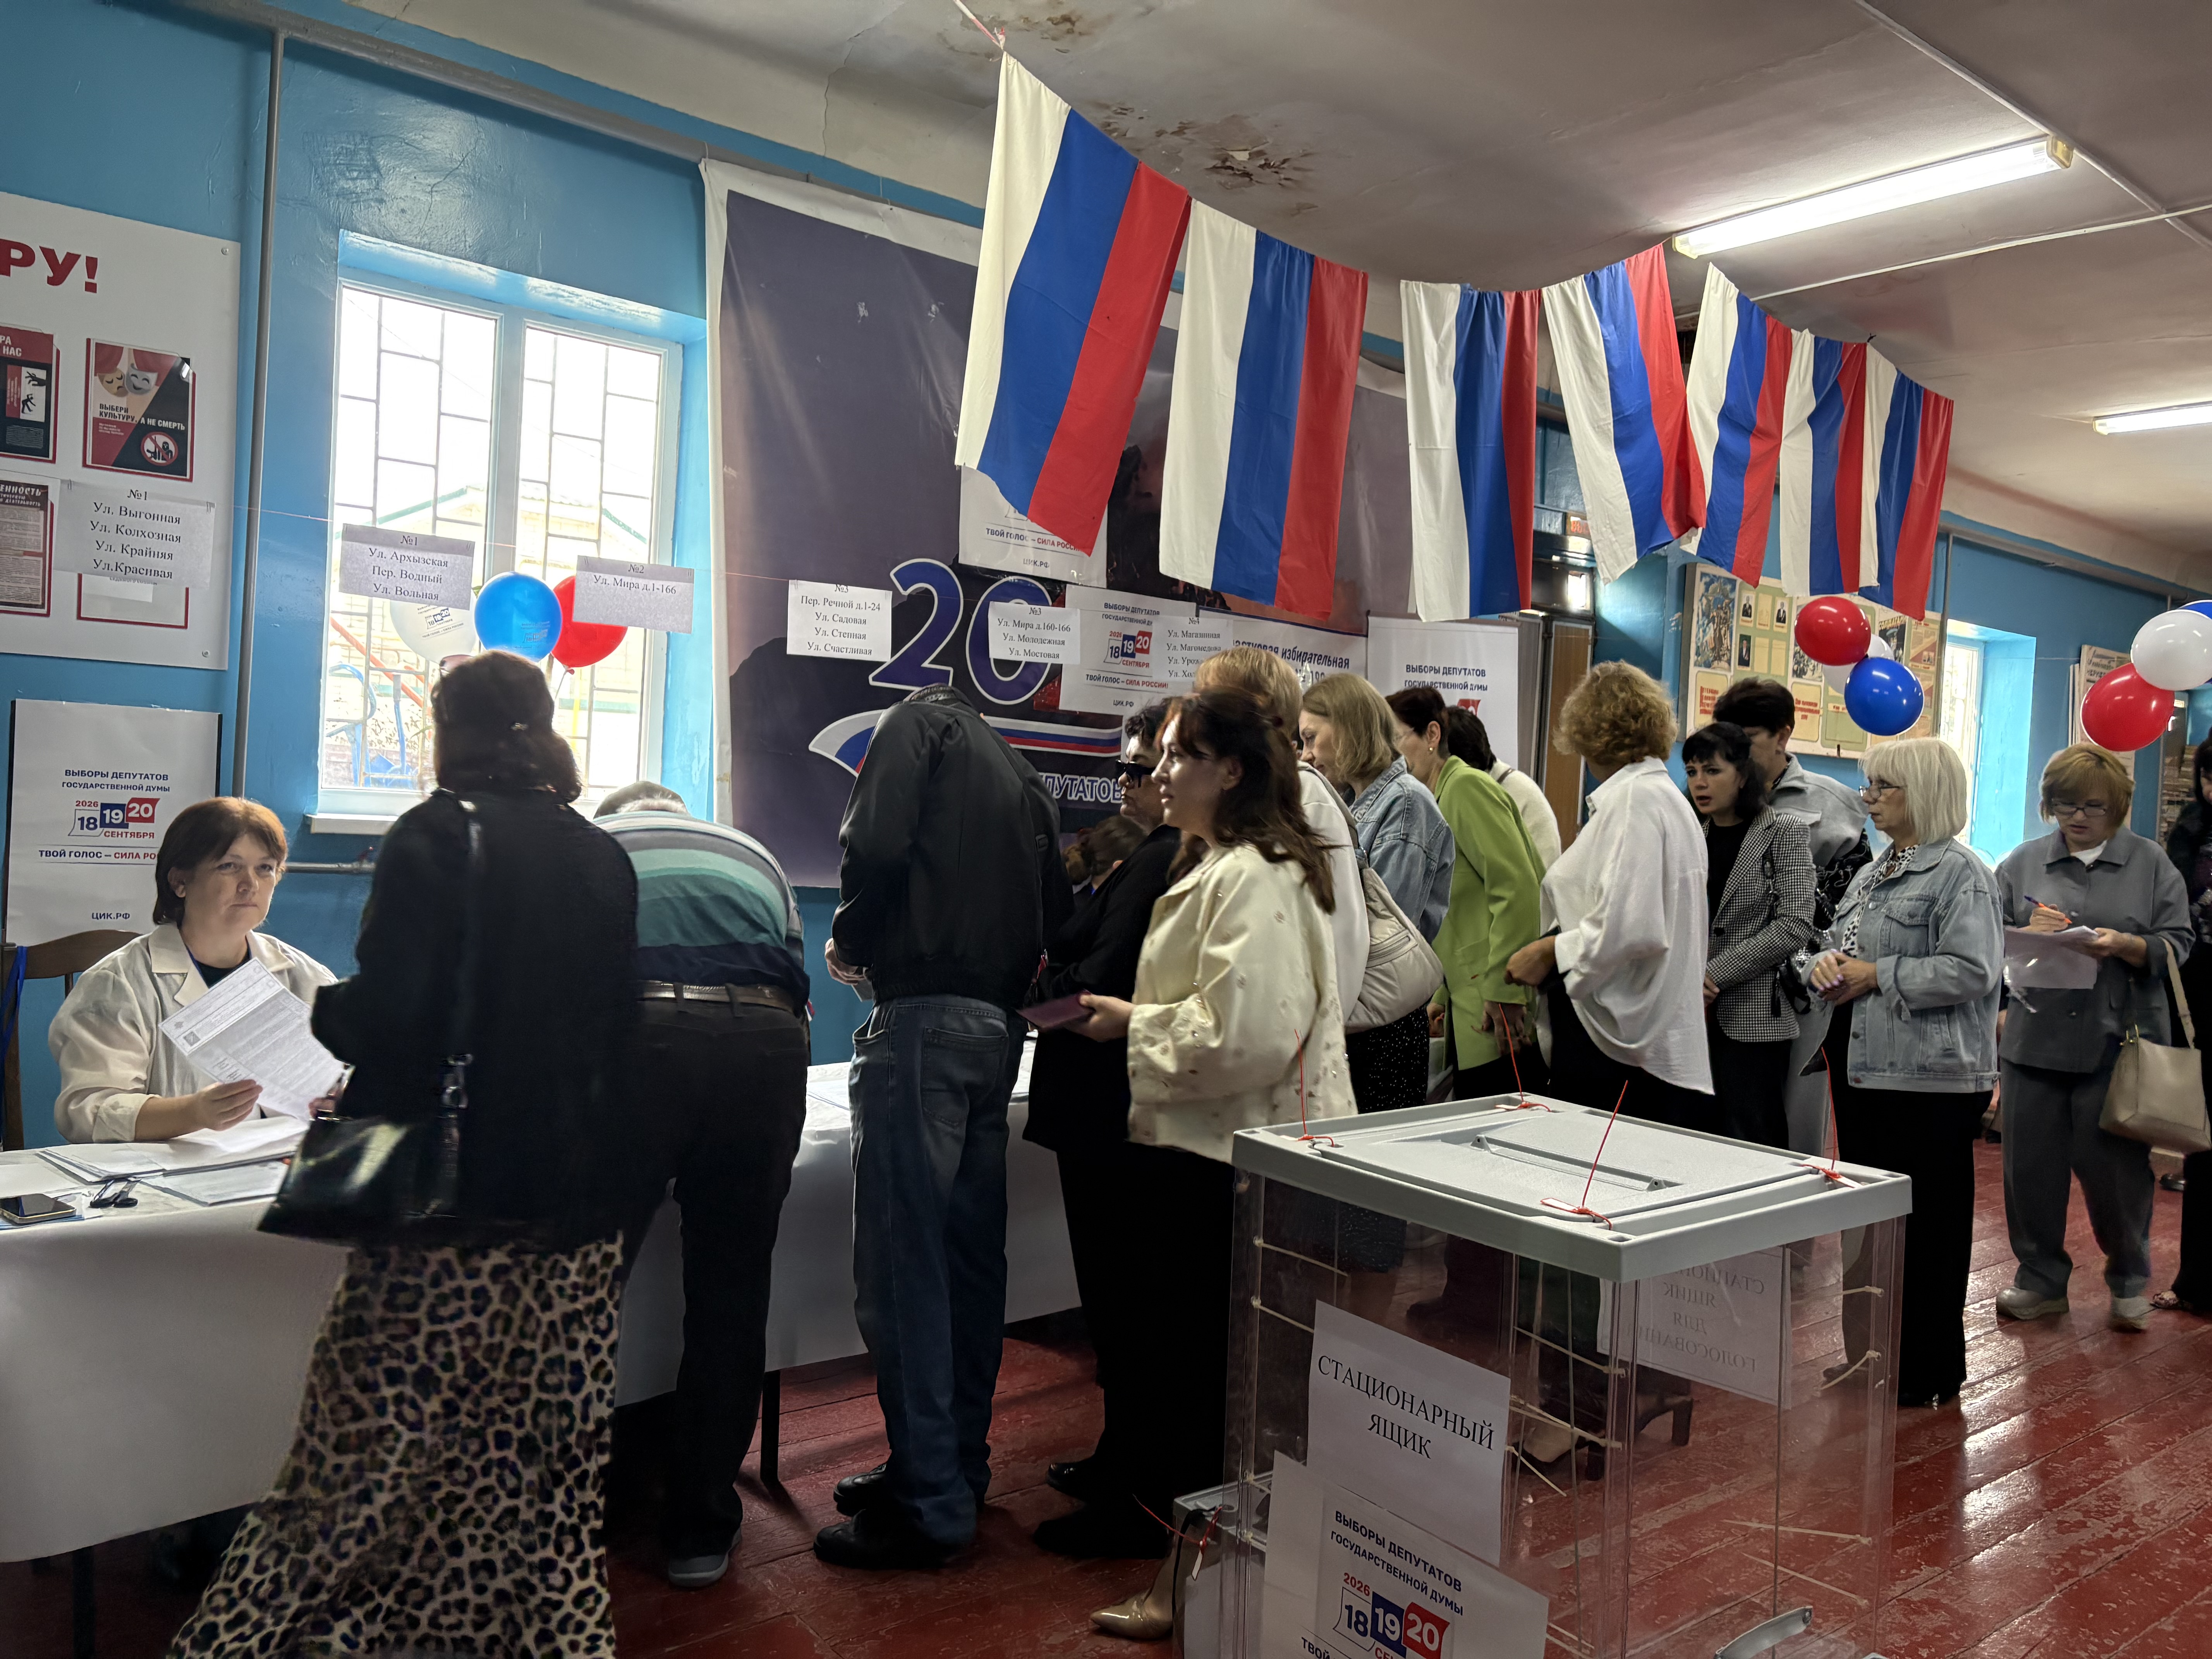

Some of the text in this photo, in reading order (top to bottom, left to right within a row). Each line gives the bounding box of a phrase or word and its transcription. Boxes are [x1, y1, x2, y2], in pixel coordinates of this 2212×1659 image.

[3, 345, 22, 357] НАС
[100, 403, 129, 414] ВЫБЕРИ
[158, 420, 185, 430] СМЕРТЬ
[119, 506, 180, 524] Выгонная
[90, 520, 180, 543] Ул. Колхозная
[986, 528, 1005, 538] ТВОЙ
[1006, 532, 1029, 542] ГОЛОС
[1037, 538, 1055, 547] СИЛА
[400, 535, 417, 546] №1
[96, 540, 173, 560] Ул. Крайняя
[369, 548, 448, 567] Ул. Архызская
[1023, 558, 1049, 568] ЦИК.РФ
[373, 565, 442, 584] Пер. Водный
[628, 564, 644, 574] №2
[594, 575, 610, 585] Ул.
[613, 577, 639, 591] Мира
[835, 584, 848, 593] №3
[373, 583, 439, 600] Ул. Вольная
[801, 595, 820, 607] Пер.
[823, 598, 853, 608] Речной
[1104, 603, 1130, 612] ВЫБОРЫ
[1029, 607, 1041, 615] №3
[832, 614, 866, 625] Садовая
[998, 618, 1010, 627] Ул.
[1012, 620, 1034, 630] Мира
[1102, 613, 1146, 625] ГОСУДАРСТВЕННОЙ
[815, 627, 866, 640] Ул. Степная
[1003, 632, 1065, 646] Ул. Молодежная
[1168, 630, 1220, 639] Ул. Магазинная
[807, 642, 872, 655] Ул. Счастливая
[1009, 647, 1059, 659] Ул. Мостовая
[1109, 635, 1149, 659] 18 19 20
[1122, 659, 1149, 668] СЕНТЯБРЯ
[1281, 646, 1350, 669] избирательная
[1406, 664, 1486, 677] ВЫБОРЫ ДЕПУТАТОВ
[65, 769, 168, 781] ВЫБОРЫ ДЕПУТАТОВ
[62, 781, 144, 791] ГОСУДАРСТВЕННОЙ
[1039, 773, 1122, 804] ПУТАТОВ
[78, 803, 153, 831] 18 19 20
[103, 831, 155, 839] СЕНТЯБРЯ
[39, 849, 66, 858] ТВОЙ
[91, 912, 130, 921] ЦИК.РФ
[1318, 1355, 1494, 1451] СТАЦИОНАРНЫЙ
[1367, 1414, 1431, 1459] ЯЩИК
[1335, 1510, 1462, 1592] ВЫБОРЫ ДЕПУТАТОВ
[1331, 1531, 1463, 1616] ГОСУДАРСТВЕННОЙ ДУМЫ
[1343, 1572, 1370, 1597] 2026
[1344, 1604, 1439, 1651] 18 19 20
